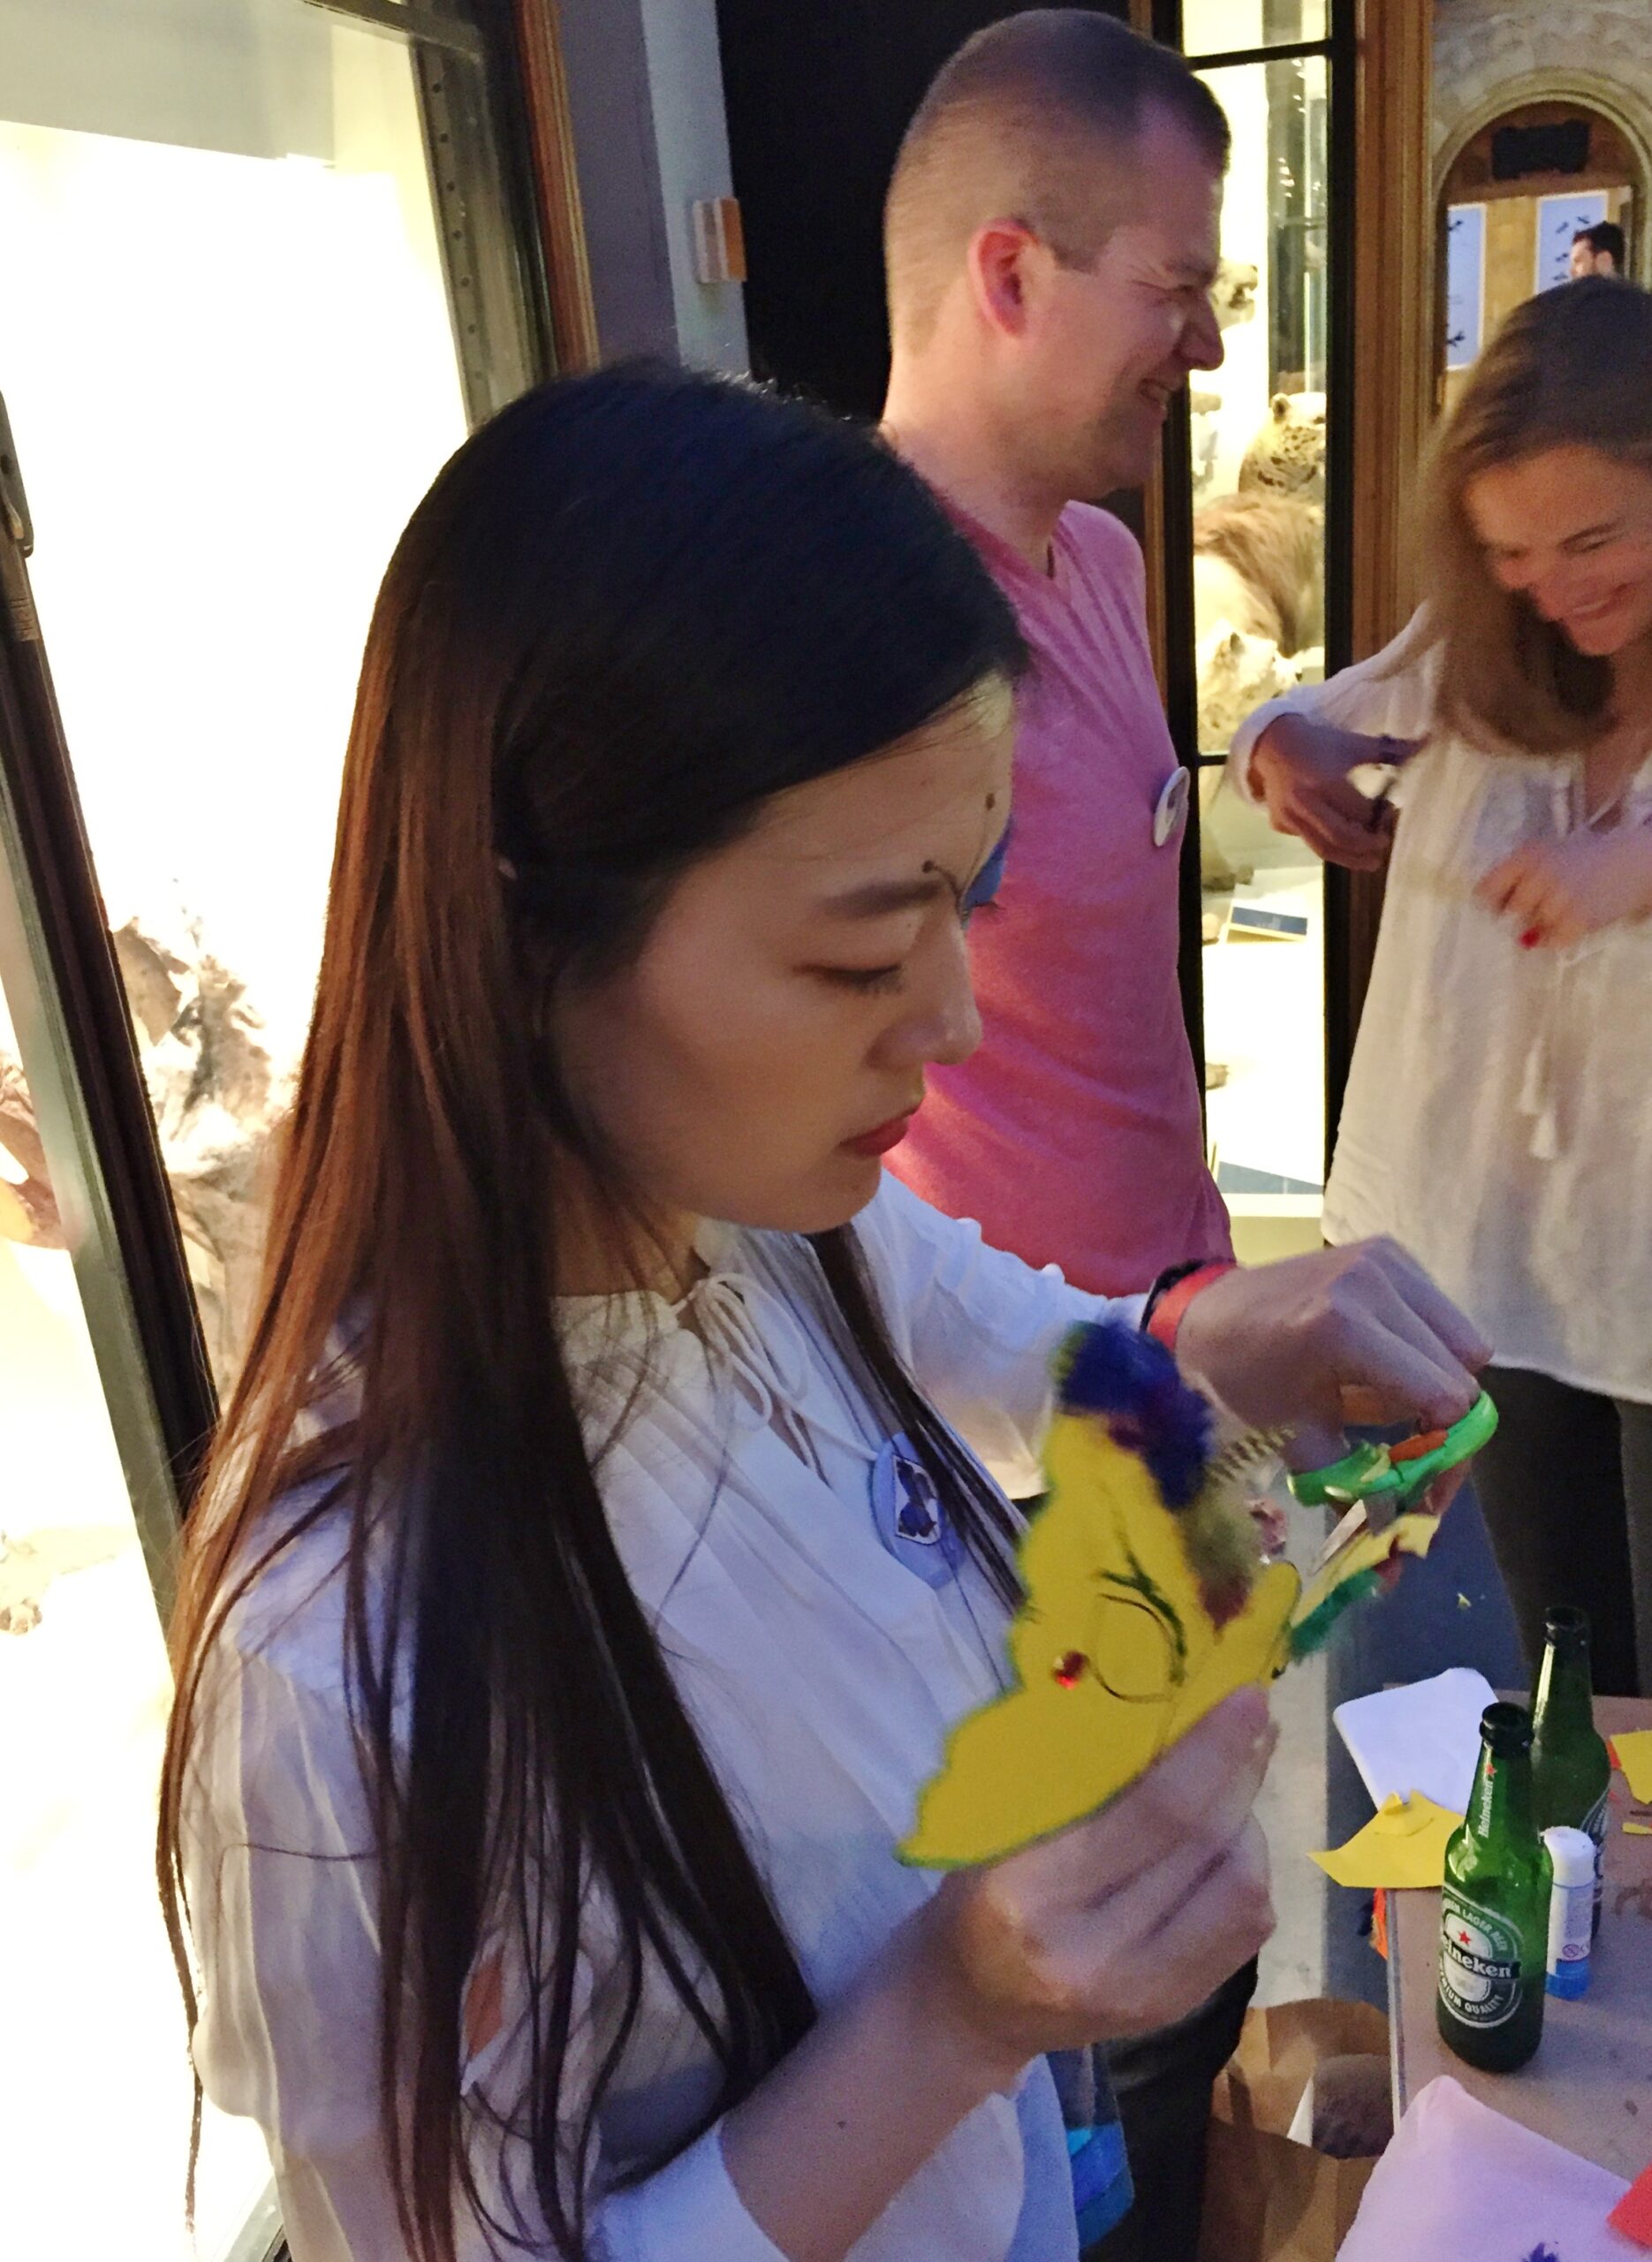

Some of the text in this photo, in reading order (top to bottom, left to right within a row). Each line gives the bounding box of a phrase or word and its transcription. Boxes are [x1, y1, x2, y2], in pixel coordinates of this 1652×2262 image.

[1478, 1780, 1493, 1839] Heineken
[1462, 1909, 1492, 1933] LAGER
[1441, 1935, 1511, 1977] eineken
[1464, 1994, 1504, 2015] QUALITY
